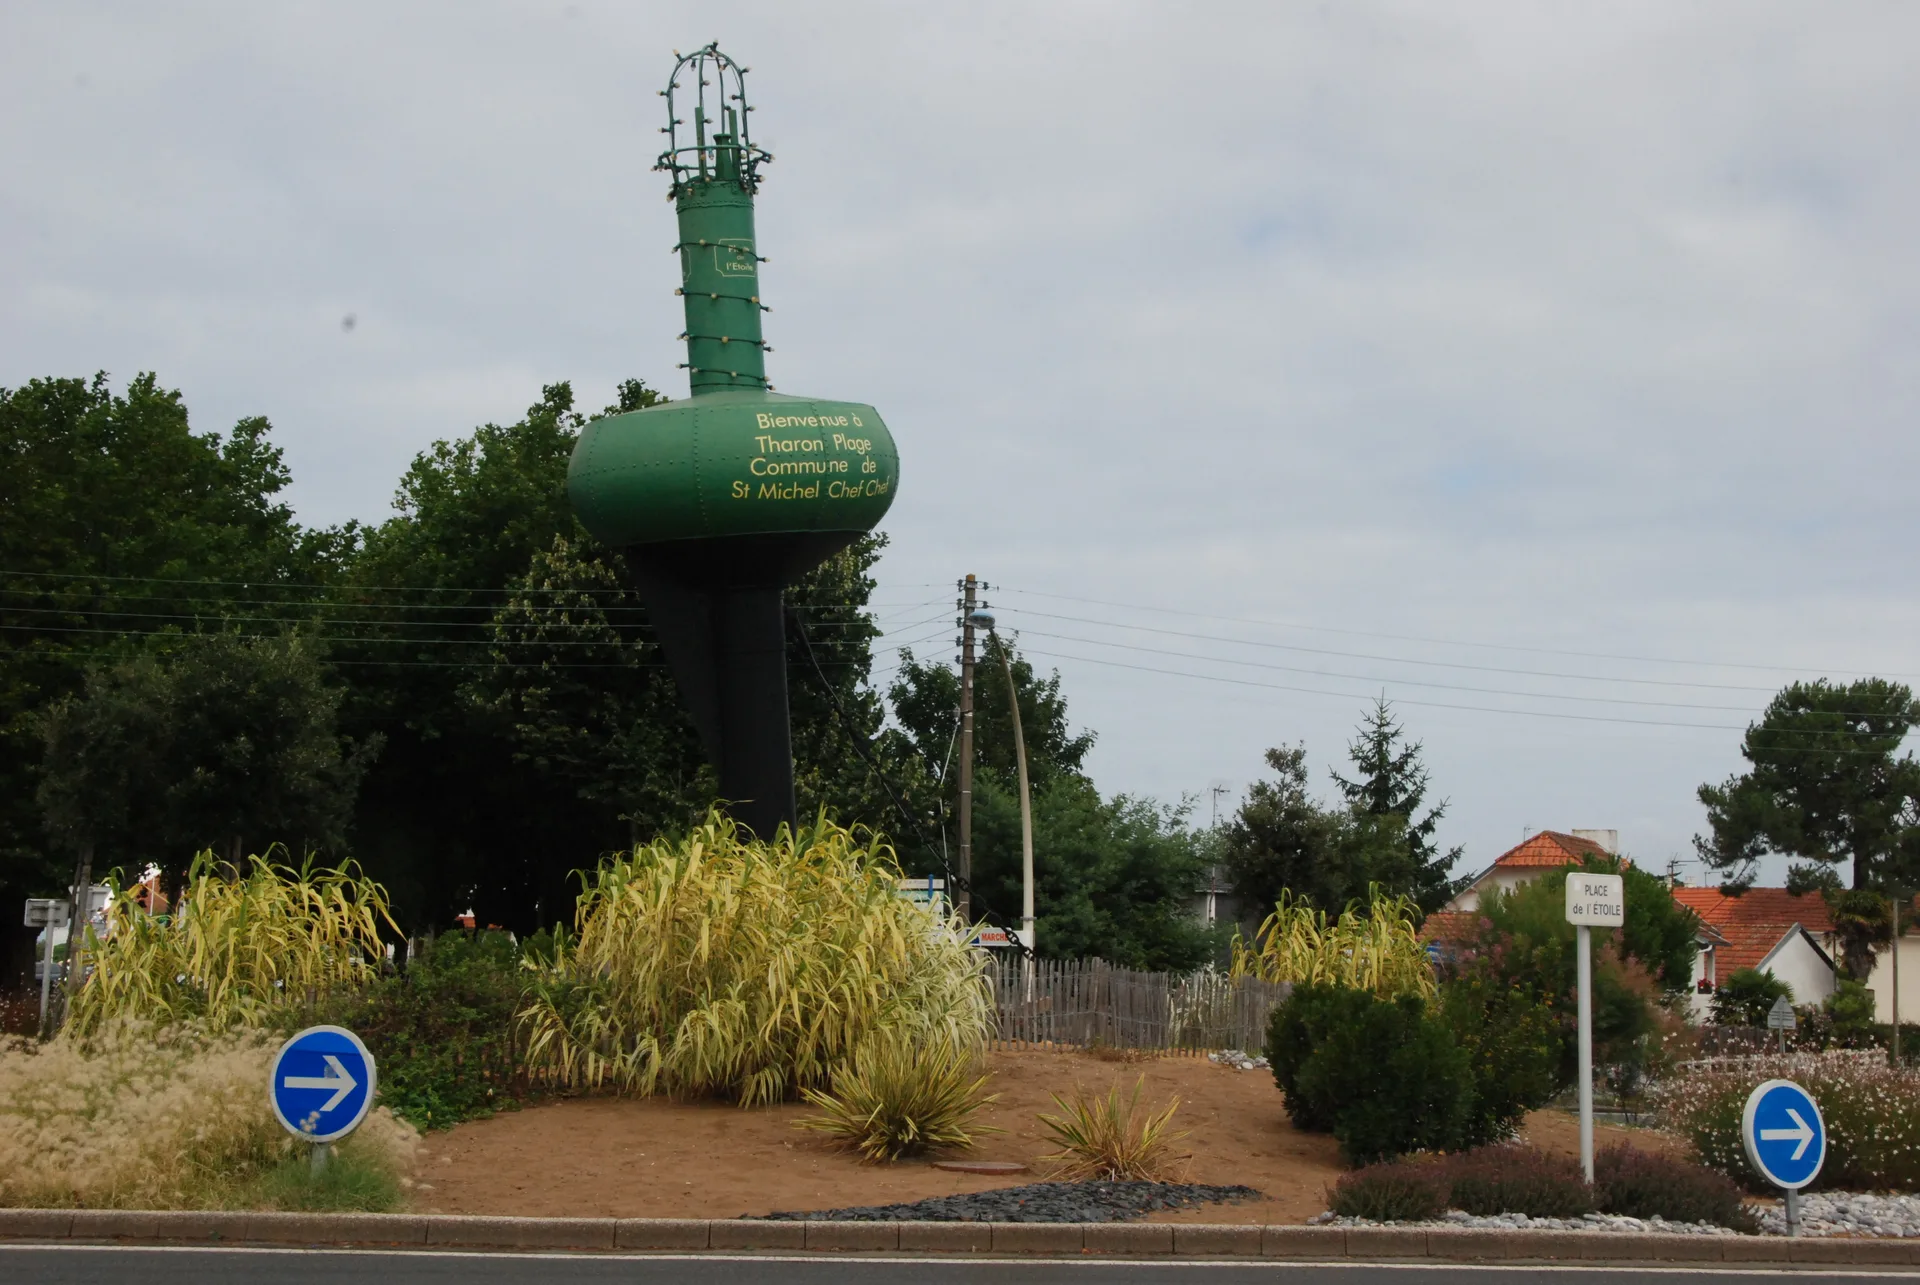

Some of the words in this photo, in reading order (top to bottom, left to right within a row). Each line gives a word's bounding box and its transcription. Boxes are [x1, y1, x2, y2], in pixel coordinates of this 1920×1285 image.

[756, 412, 849, 430] Bienvenue
[853, 412, 863, 427] à
[755, 435, 824, 453] Tharon
[833, 433, 872, 454] Plage
[750, 457, 848, 476] Commune
[862, 456, 877, 473] de
[731, 480, 750, 499] St
[758, 480, 820, 499] Michel
[828, 480, 865, 499] Chef
[865, 476, 890, 497] Chef
[1584, 884, 1608, 896] PLACE
[1572, 903, 1583, 914] de
